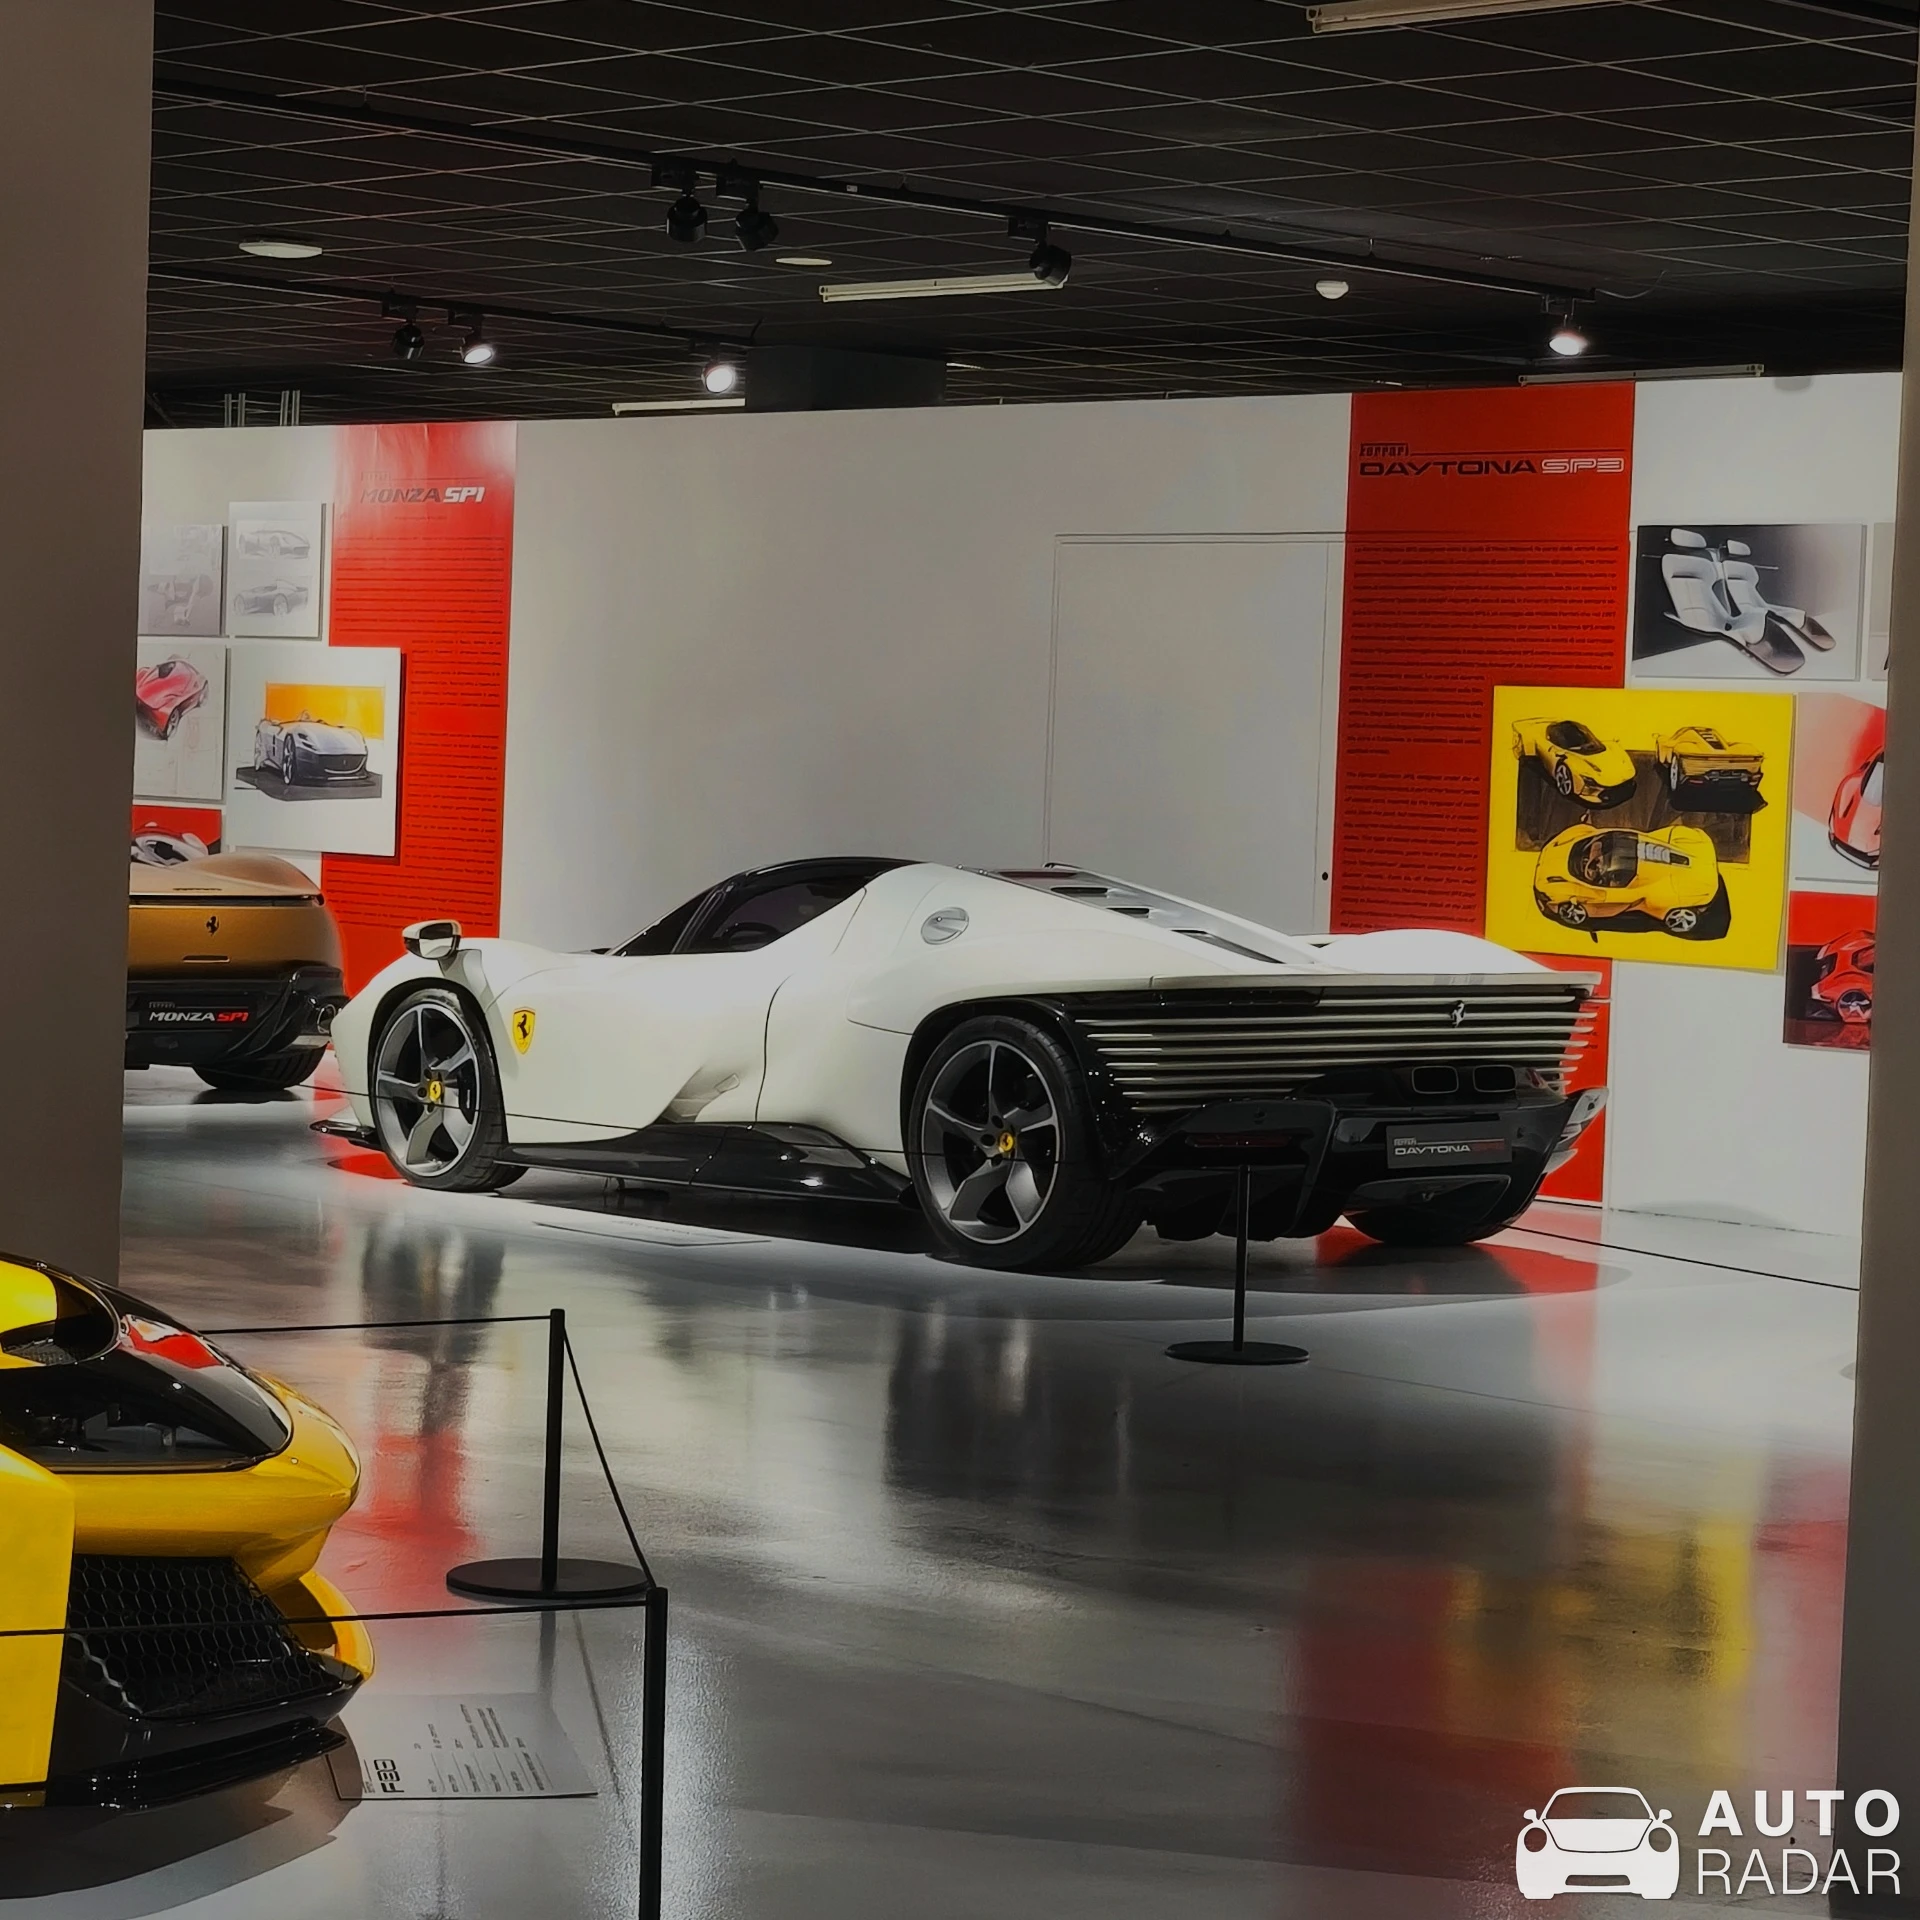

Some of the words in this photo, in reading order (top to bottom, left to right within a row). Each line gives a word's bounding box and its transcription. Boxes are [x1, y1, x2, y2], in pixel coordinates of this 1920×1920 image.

[1359, 459, 1537, 477] DAYTONA
[1541, 457, 1625, 474] SP3
[360, 487, 441, 503] MONZA
[442, 486, 486, 503] SP1
[149, 1012, 216, 1022] MONZA
[216, 1012, 249, 1022] SP1
[1394, 1144, 1471, 1155] DAYTONA
